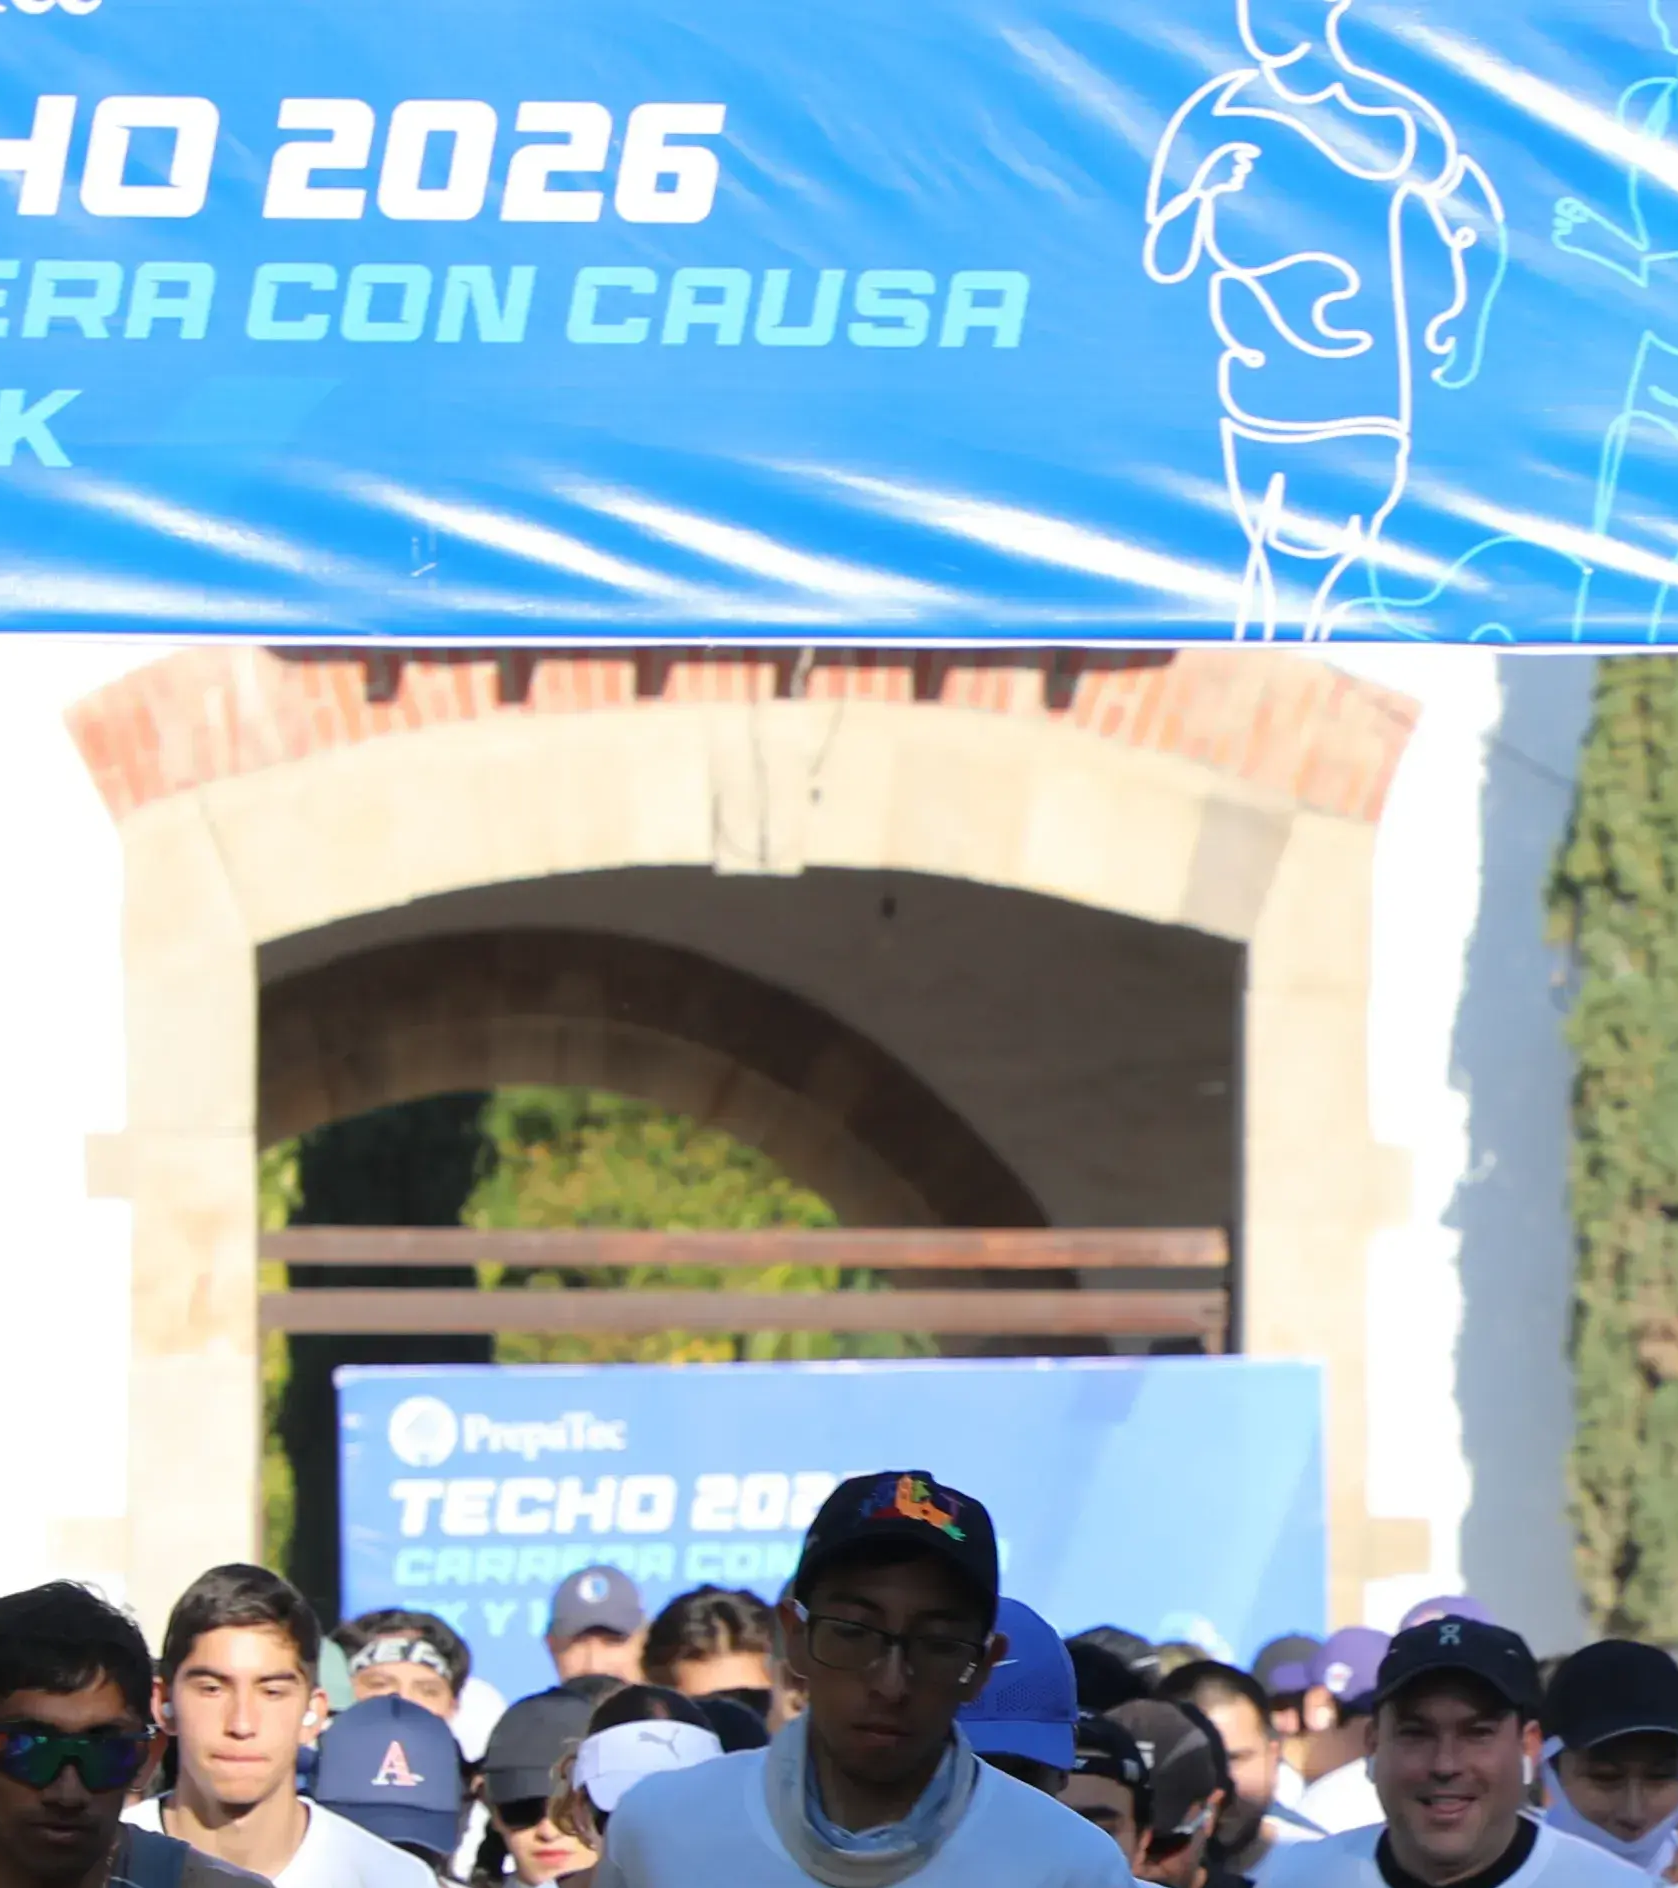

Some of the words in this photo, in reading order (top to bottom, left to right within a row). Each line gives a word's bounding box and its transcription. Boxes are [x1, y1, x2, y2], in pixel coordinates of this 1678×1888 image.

[263, 99, 726, 223] 2026
[245, 262, 536, 343] CON
[566, 266, 1030, 349] CAUSA
[463, 1411, 628, 1461] PrepaTec
[388, 1473, 679, 1538] TECHO
[689, 1471, 852, 1533] 202
